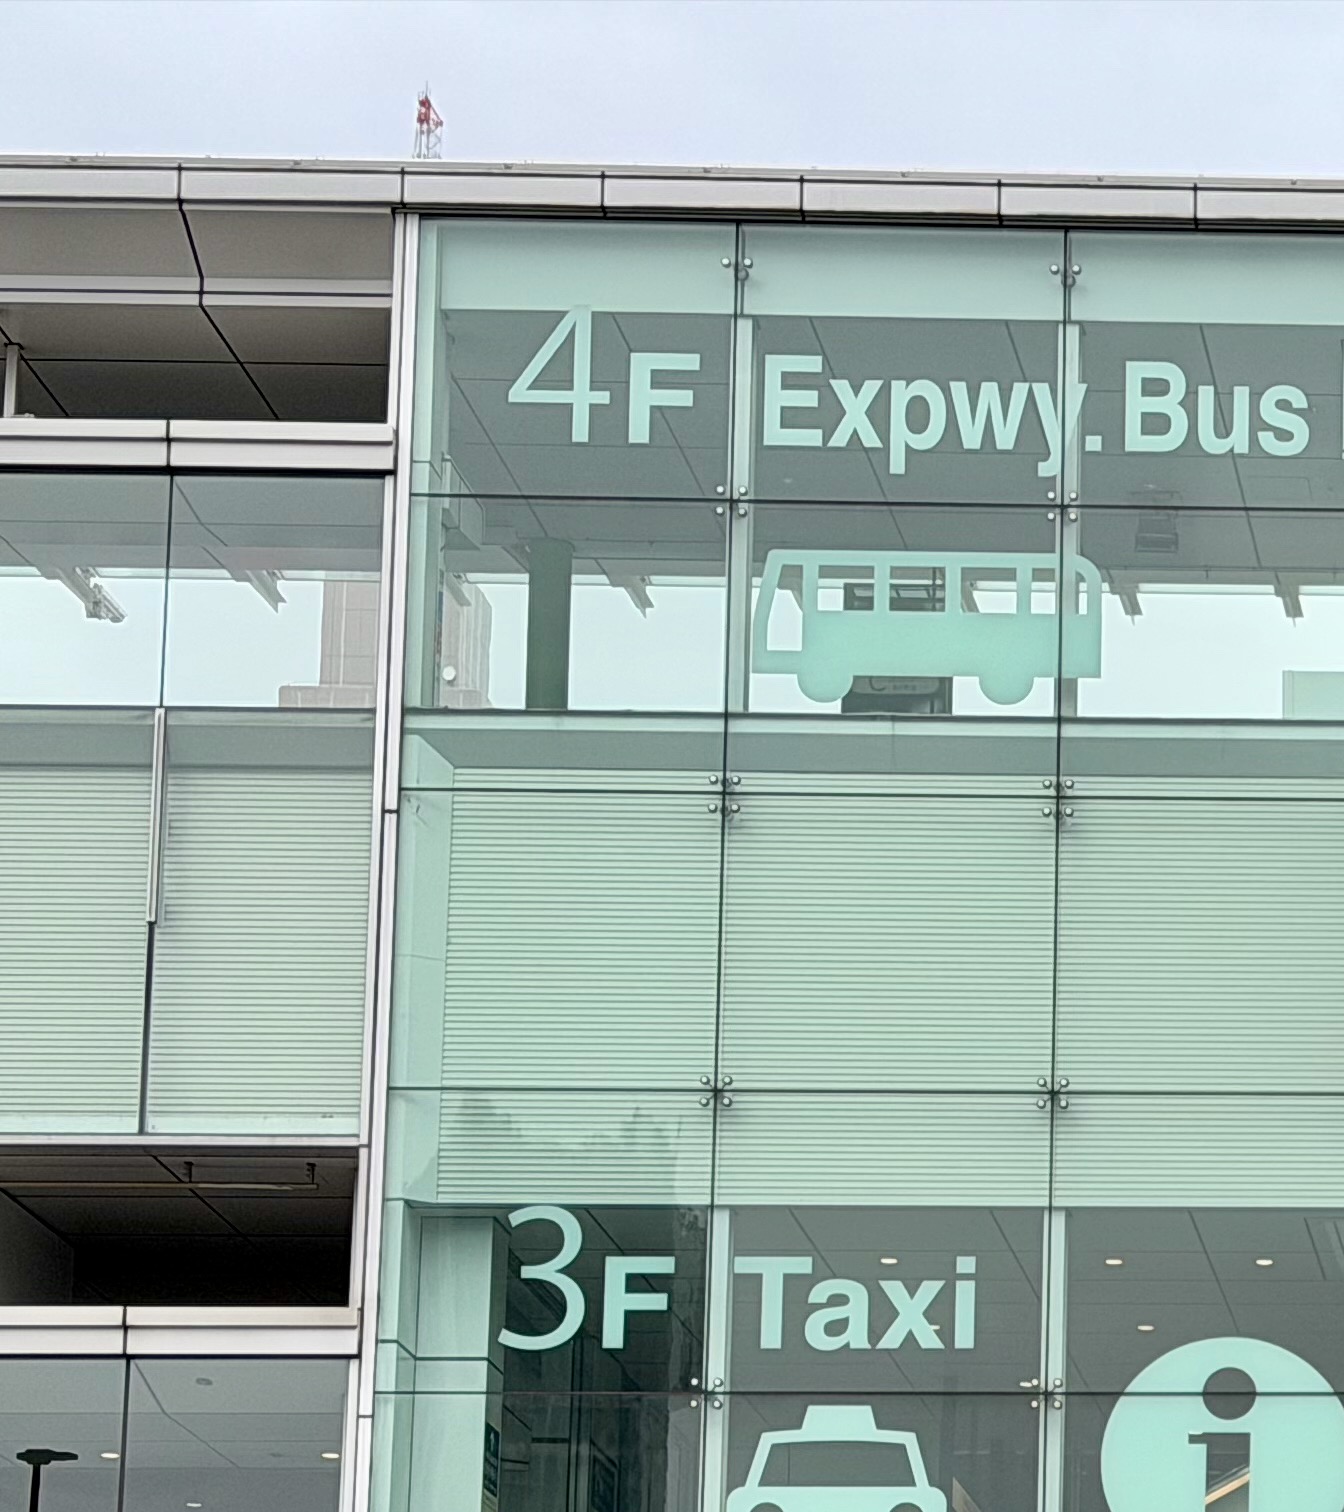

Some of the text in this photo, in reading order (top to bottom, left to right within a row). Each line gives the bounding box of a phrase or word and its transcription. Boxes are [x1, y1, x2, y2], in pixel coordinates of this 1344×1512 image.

[507, 305, 702, 446] 4F
[497, 1205, 977, 1351] 3F Taxi
